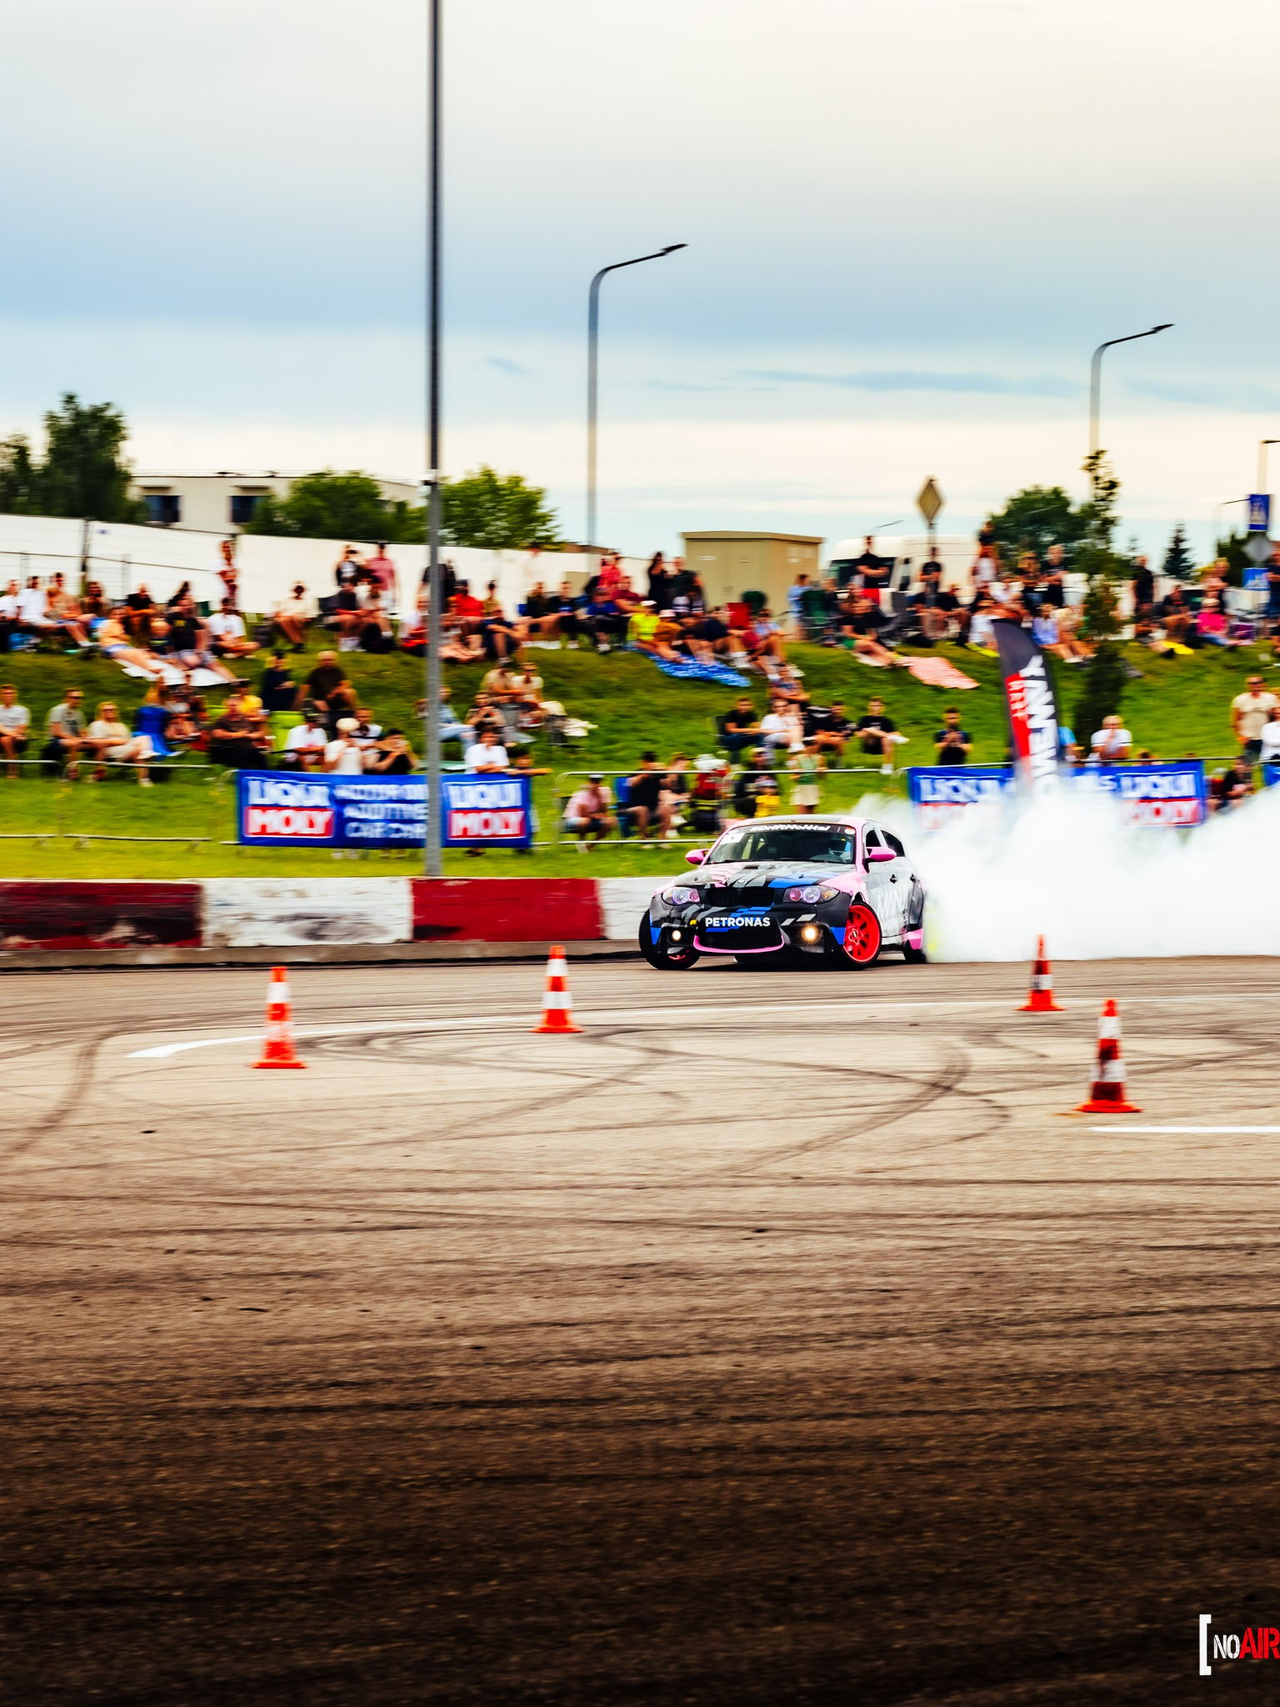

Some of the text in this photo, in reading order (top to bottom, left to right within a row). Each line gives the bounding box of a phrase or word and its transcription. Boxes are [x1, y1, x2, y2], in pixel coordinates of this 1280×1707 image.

[248, 780, 330, 807] LIQUI
[450, 783, 522, 808] LIQUI
[247, 808, 334, 837] MOLY
[451, 810, 523, 837] MOLY
[705, 917, 771, 927] PETRONAS
